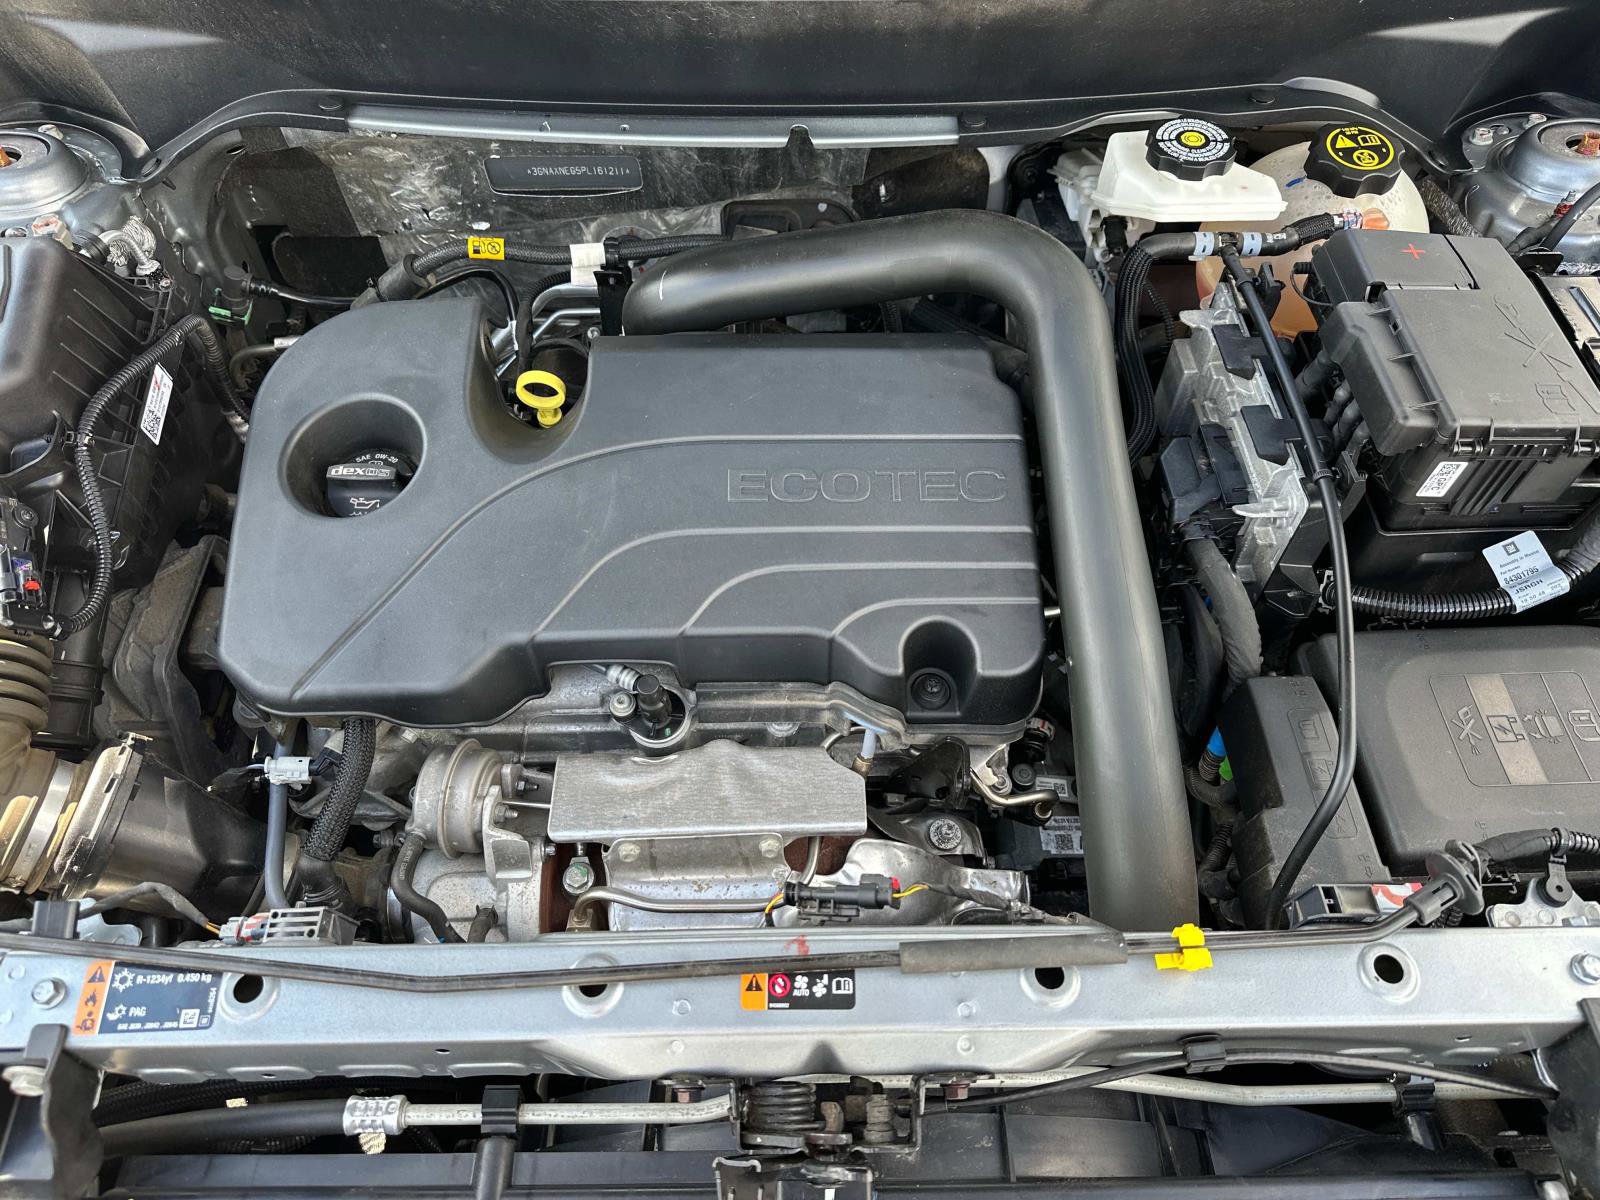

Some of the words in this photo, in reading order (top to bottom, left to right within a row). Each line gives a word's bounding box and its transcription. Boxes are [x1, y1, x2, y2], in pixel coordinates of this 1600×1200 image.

[355, 454, 371, 462] SAE
[375, 453, 398, 463] 0W-20
[331, 466, 391, 476] dexos
[727, 468, 1007, 502] ECOTEC
[1503, 566, 1539, 585] 84301795
[136, 974, 174, 985] R-1234yf
[177, 973, 200, 983] 0.450
[201, 973, 212, 984] kg
[128, 1006, 147, 1018] PAG
